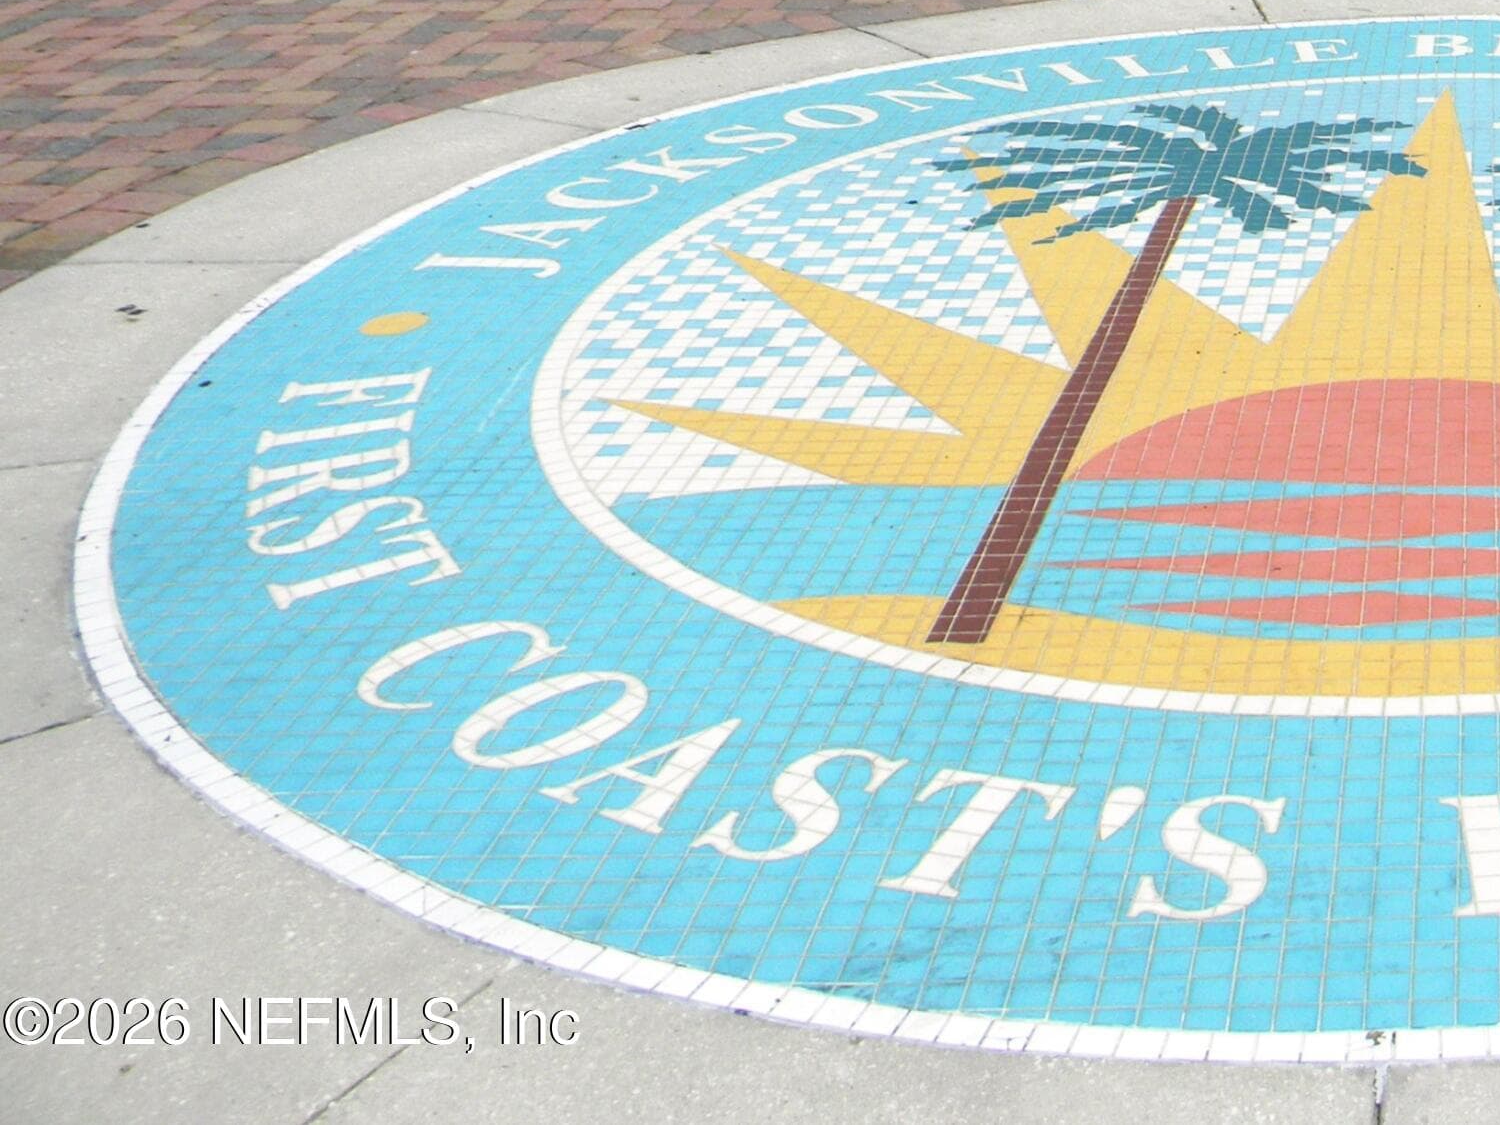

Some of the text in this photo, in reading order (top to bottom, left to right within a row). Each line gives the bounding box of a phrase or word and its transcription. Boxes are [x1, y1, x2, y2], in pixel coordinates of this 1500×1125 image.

[414, 37, 1358, 279] JACKSONVILLE
[244, 365, 462, 611] FIRST
[356, 619, 1286, 921] COAST'S
